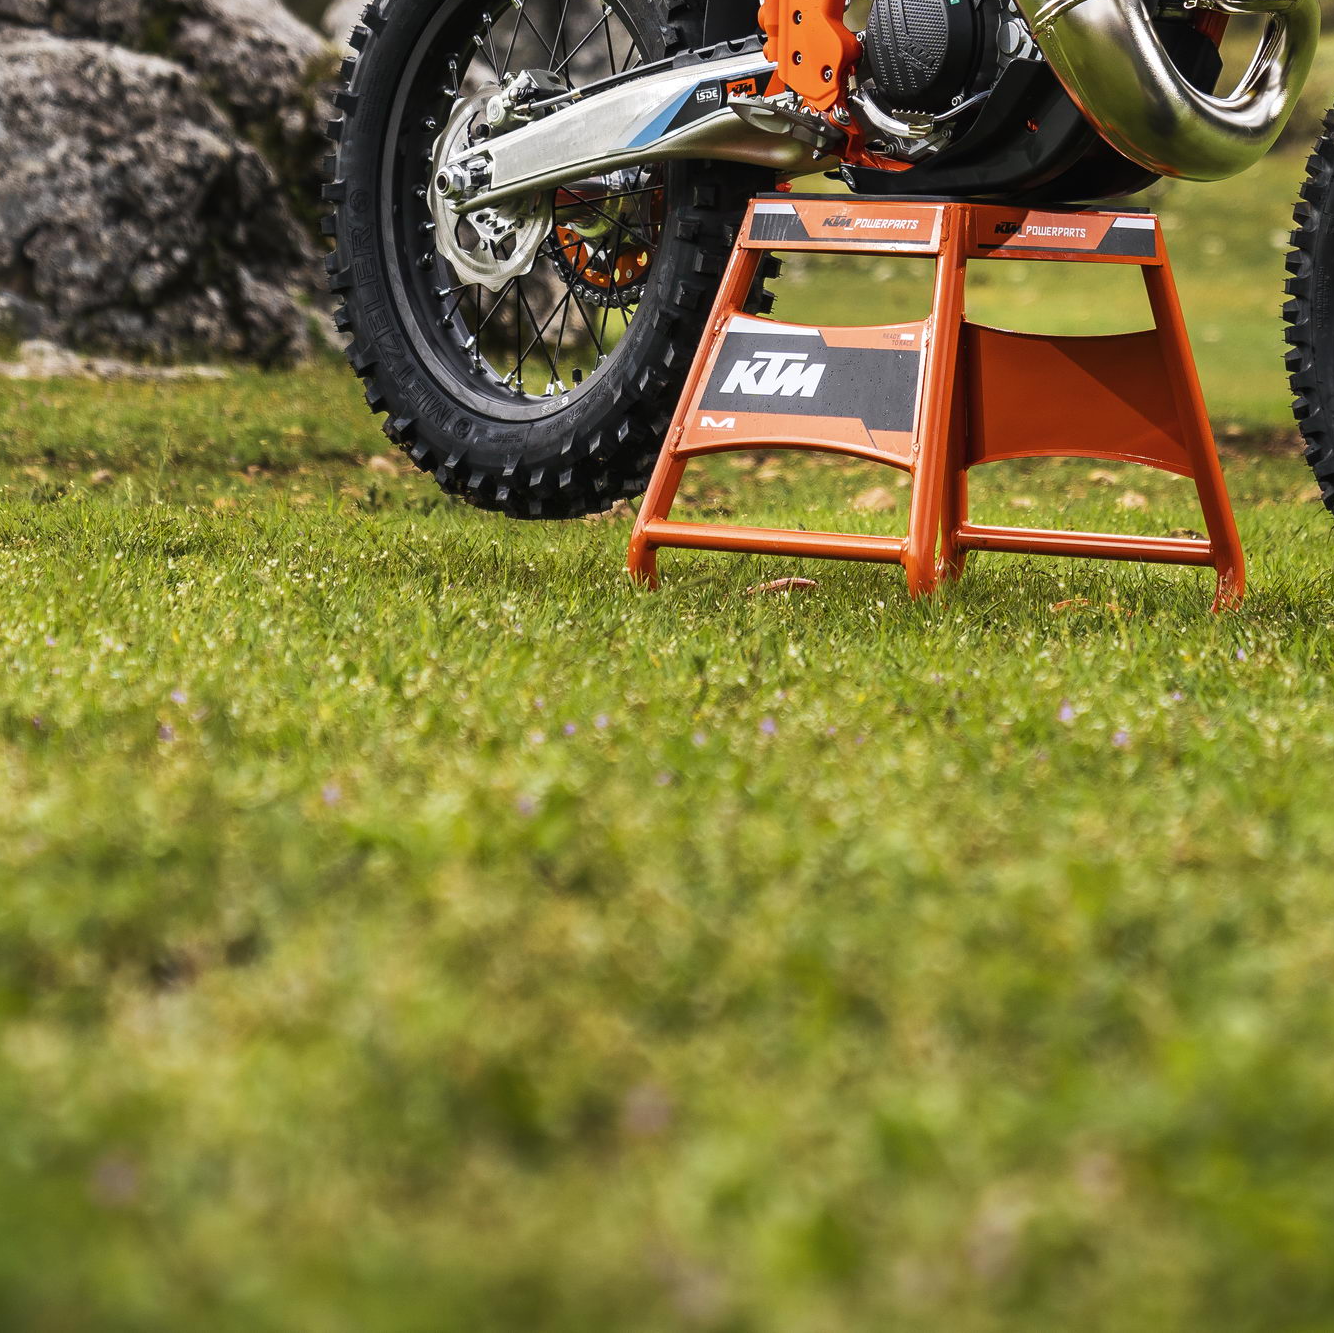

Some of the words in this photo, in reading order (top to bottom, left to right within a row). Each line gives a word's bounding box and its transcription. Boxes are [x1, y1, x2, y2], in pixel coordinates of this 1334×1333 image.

[731, 82, 753, 94] KTM
[696, 89, 718, 101] ISDE
[719, 351, 827, 398] KTM
